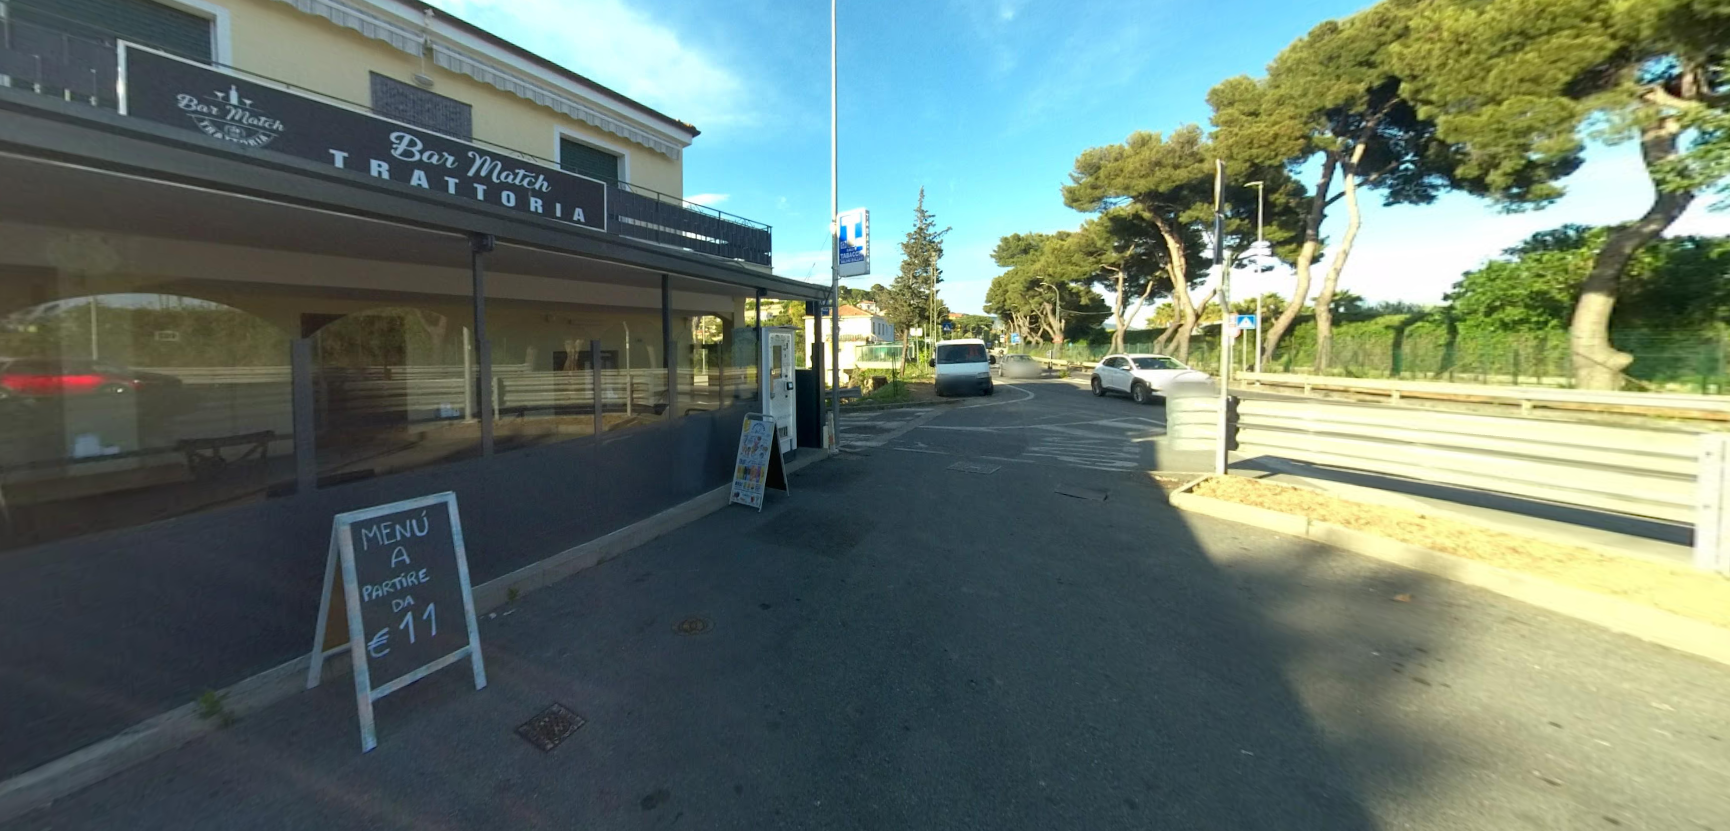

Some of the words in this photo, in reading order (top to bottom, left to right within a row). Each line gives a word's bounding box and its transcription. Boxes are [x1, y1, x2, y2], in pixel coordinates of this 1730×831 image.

[176, 93, 219, 115] Bar
[225, 105, 284, 131] Match
[389, 131, 459, 169] Bar
[467, 150, 552, 193] Match
[329, 149, 586, 223] TRATTORIA
[362, 510, 429, 550] MENÚ
[391, 546, 411, 568] A
[392, 595, 415, 613] DA
[399, 602, 437, 644] 11
